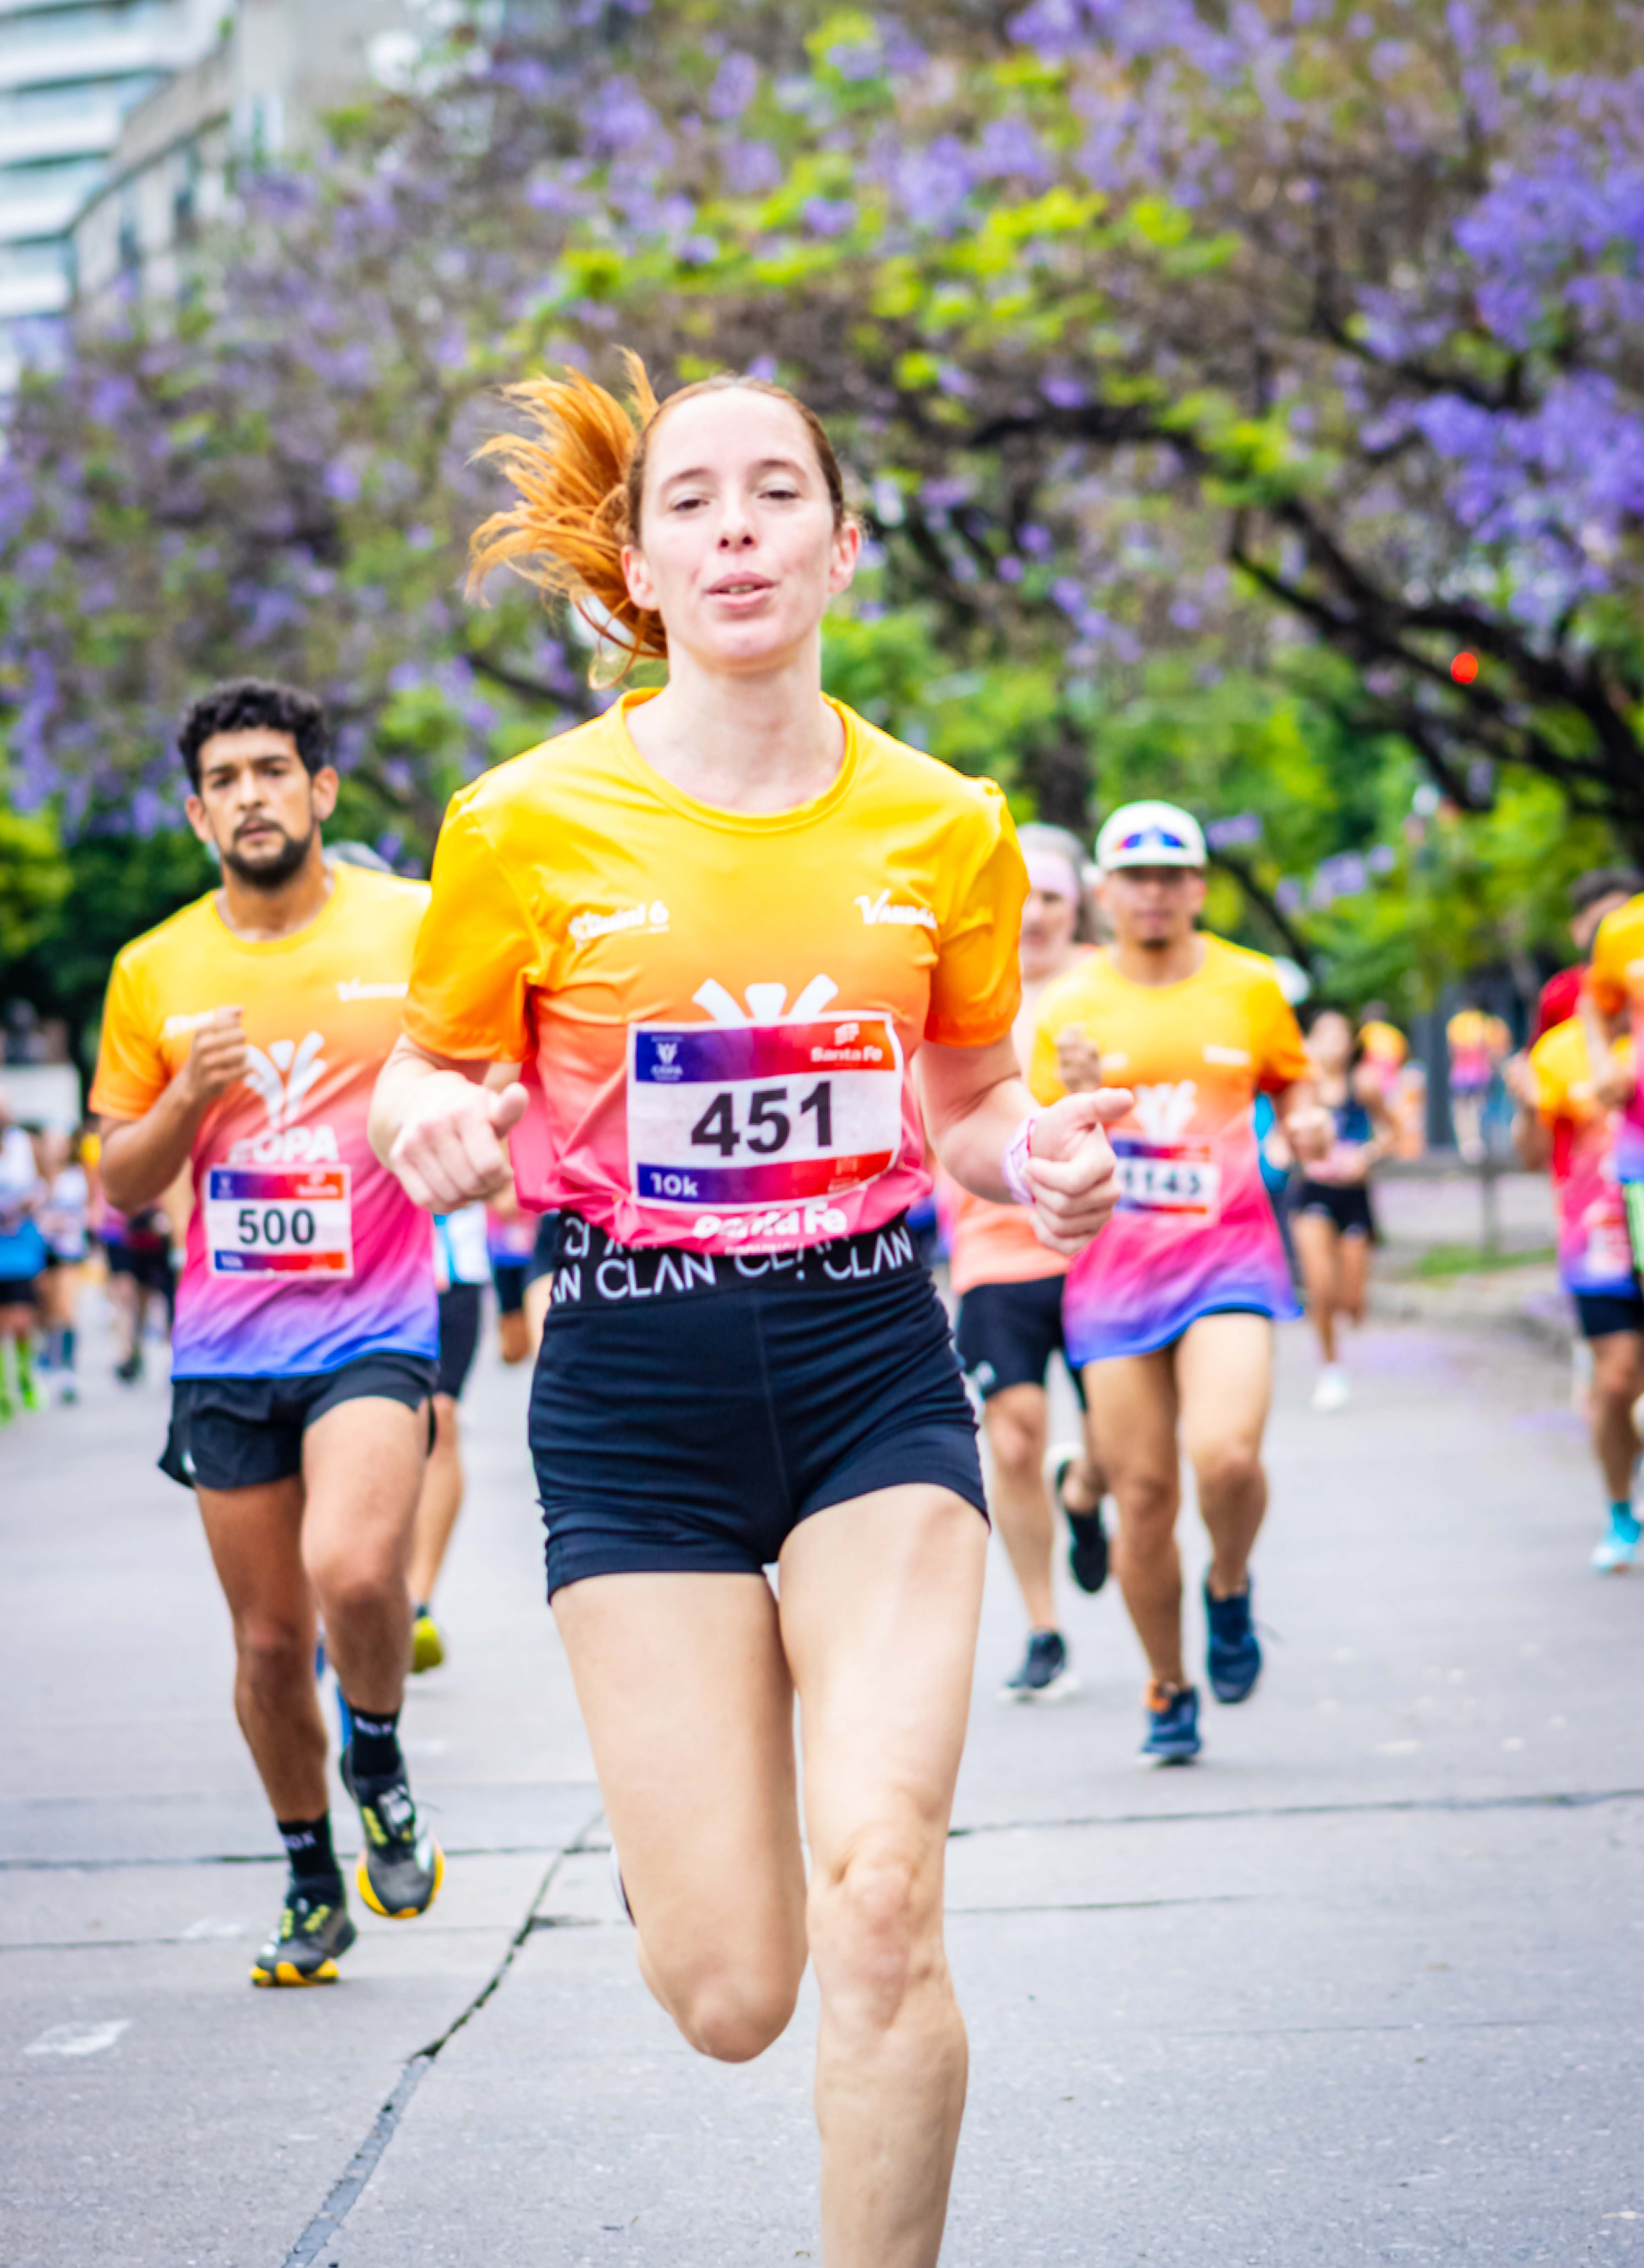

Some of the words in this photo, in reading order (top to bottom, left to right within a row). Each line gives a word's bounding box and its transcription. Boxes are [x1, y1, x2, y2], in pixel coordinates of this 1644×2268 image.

[691, 1080, 833, 1158] 451
[650, 1172, 698, 1197] 10k
[238, 1208, 316, 1245] 500
[804, 1202, 847, 1234] Fe
[596, 1253, 716, 1300] CLAN
